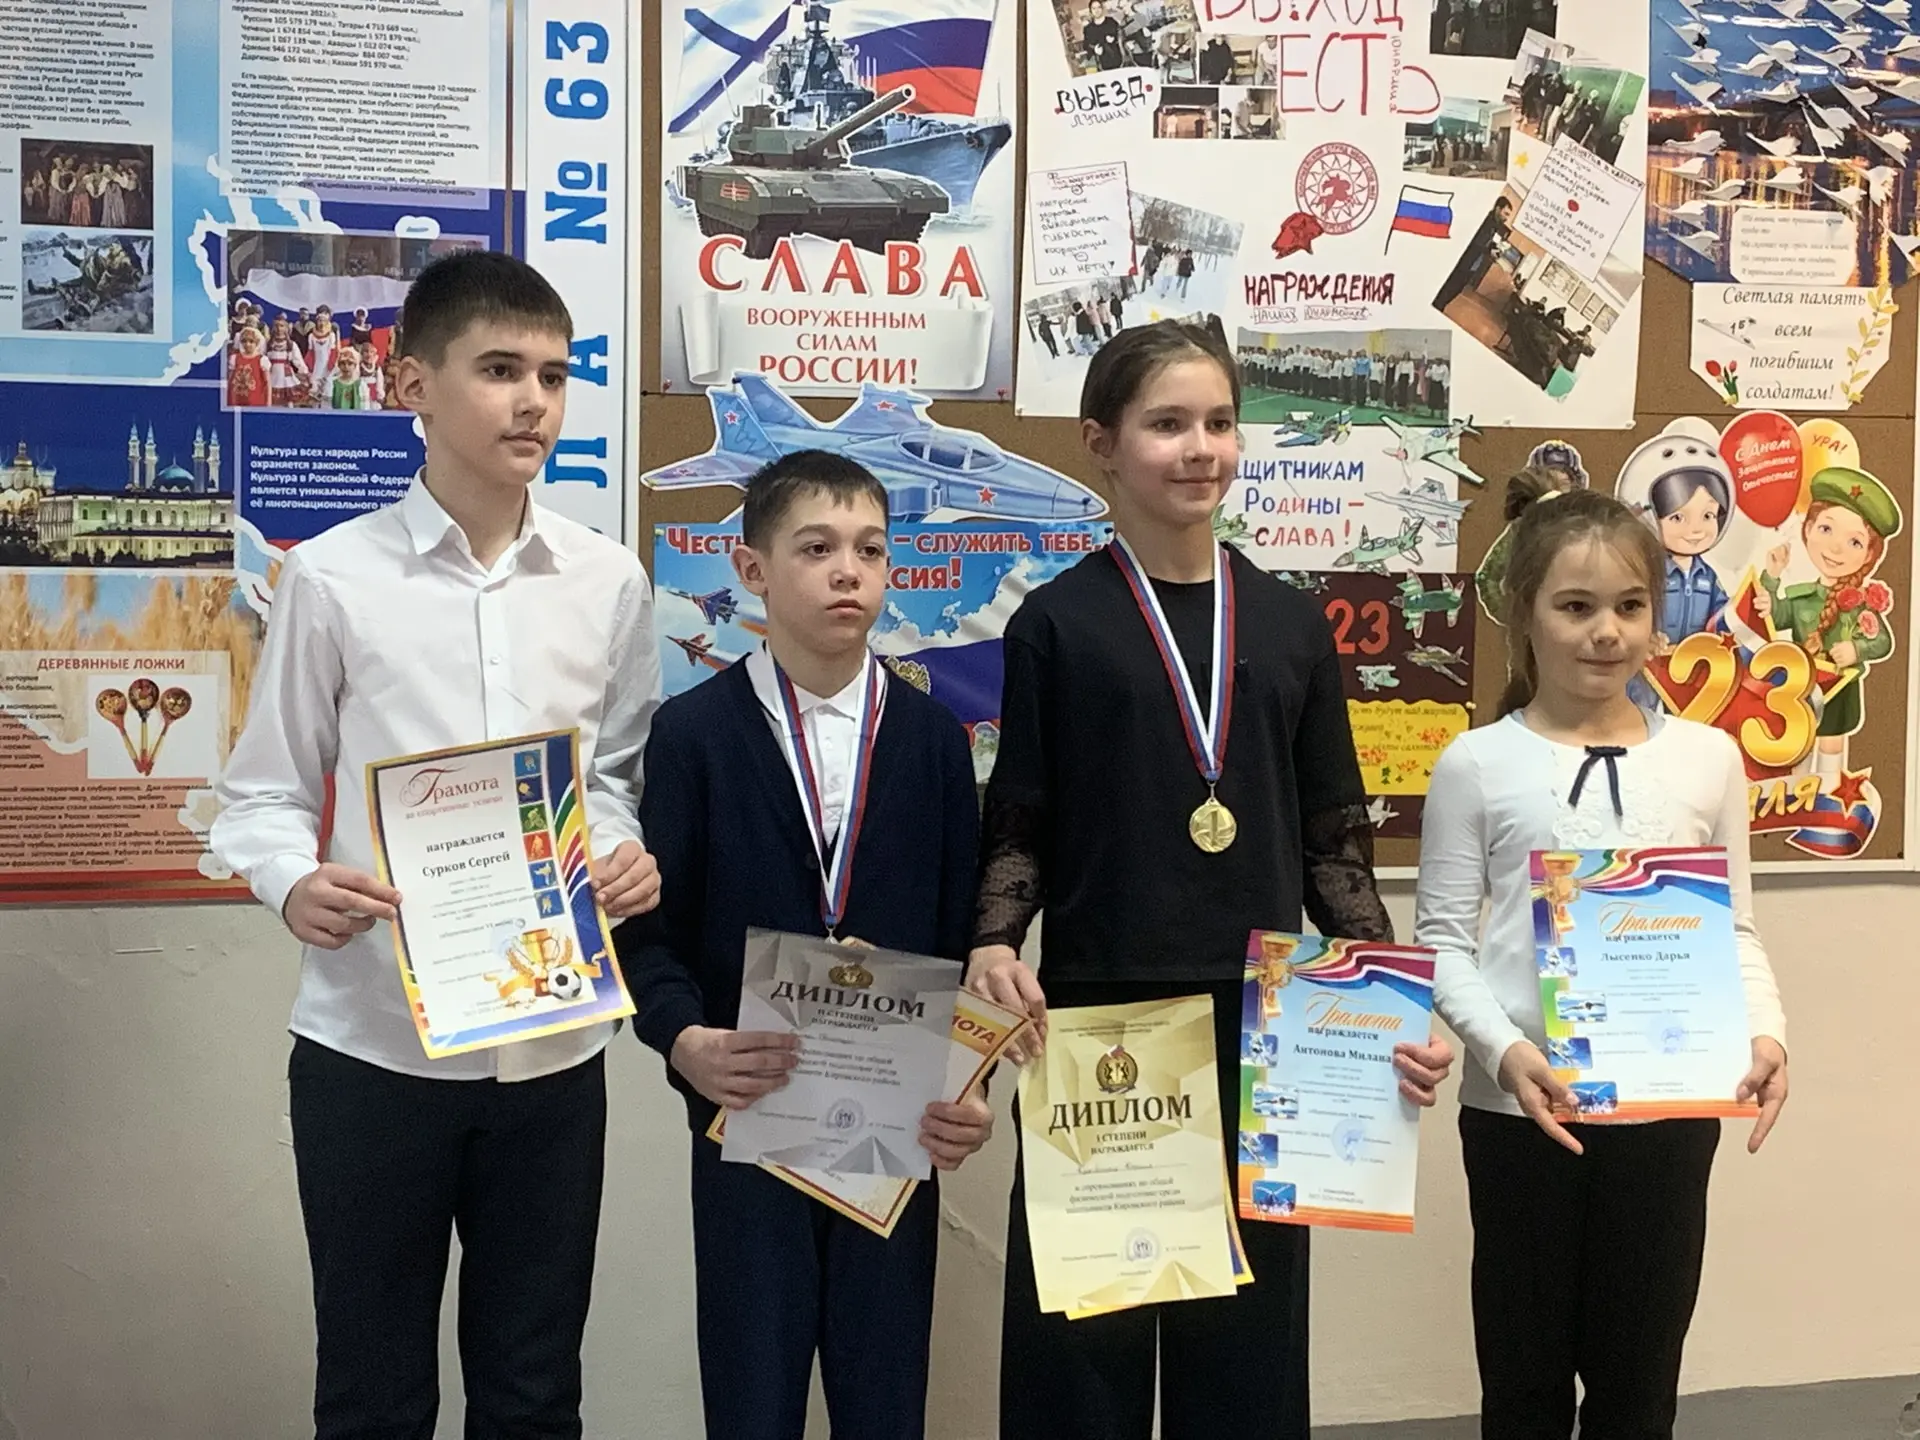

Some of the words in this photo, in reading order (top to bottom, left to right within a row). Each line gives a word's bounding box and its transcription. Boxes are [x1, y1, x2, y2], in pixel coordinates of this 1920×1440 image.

[545, 20, 609, 120] 63
[1280, 32, 1441, 115] ЕСТЬ
[699, 237, 985, 298] СЛАВА
[1244, 271, 1395, 306] НАГРАЖДЕНИЯ
[1723, 286, 1794, 304] Светлая
[1800, 291, 1866, 306] память
[748, 308, 926, 329] ВООРУЖЕННЫМ
[1775, 324, 1812, 337] всем
[797, 334, 877, 352] СИЛАМ
[760, 355, 918, 385] РОССИИ!
[1750, 350, 1834, 370] погибшим
[1746, 380, 1834, 400] солдатам!
[250, 446, 298, 458] Культура
[300, 448, 322, 456] всех
[325, 449, 369, 458] народов
[372, 448, 407, 458] России
[1812, 434, 1848, 455] УРА!
[250, 461, 309, 470] охраняется
[312, 462, 360, 470] законом.
[1235, 460, 1364, 484] ЩИТНИКАМ
[250, 473, 298, 484] Культура
[308, 473, 368, 484] Российской
[250, 486, 296, 495] является
[299, 487, 366, 496] уникальным
[250, 498, 262, 508] её
[265, 500, 378, 510] многонационального
[915, 533, 1032, 553] СЛУЖИТЬ
[1325, 598, 1390, 654] 23
[37, 658, 129, 672] ДЕРЕВЯННЫЕ
[133, 658, 185, 670] ЛОЖКИ
[1668, 631, 1818, 768] 23
[400, 764, 500, 808] Грамота
[426, 830, 505, 854] награждается
[422, 862, 466, 880] Сурков
[468, 852, 511, 873] Сергей
[1598, 902, 1702, 934] Грамота
[1604, 932, 1681, 944] награждается
[1600, 952, 1652, 962] Лысенко
[1654, 950, 1690, 962] Дарья
[770, 980, 926, 1018] ДИПЛОМ
[1305, 992, 1404, 1032] Грамота
[1308, 1026, 1379, 1041] награждается
[1293, 1044, 1346, 1059] Антонова
[1348, 1048, 1392, 1064] Милана
[1048, 1094, 1192, 1136] ДИПЛОМ
[1102, 1130, 1147, 1142] СТЕПЕНИ
[1090, 1142, 1154, 1156] НАГРАЖДАЕТСЯ
